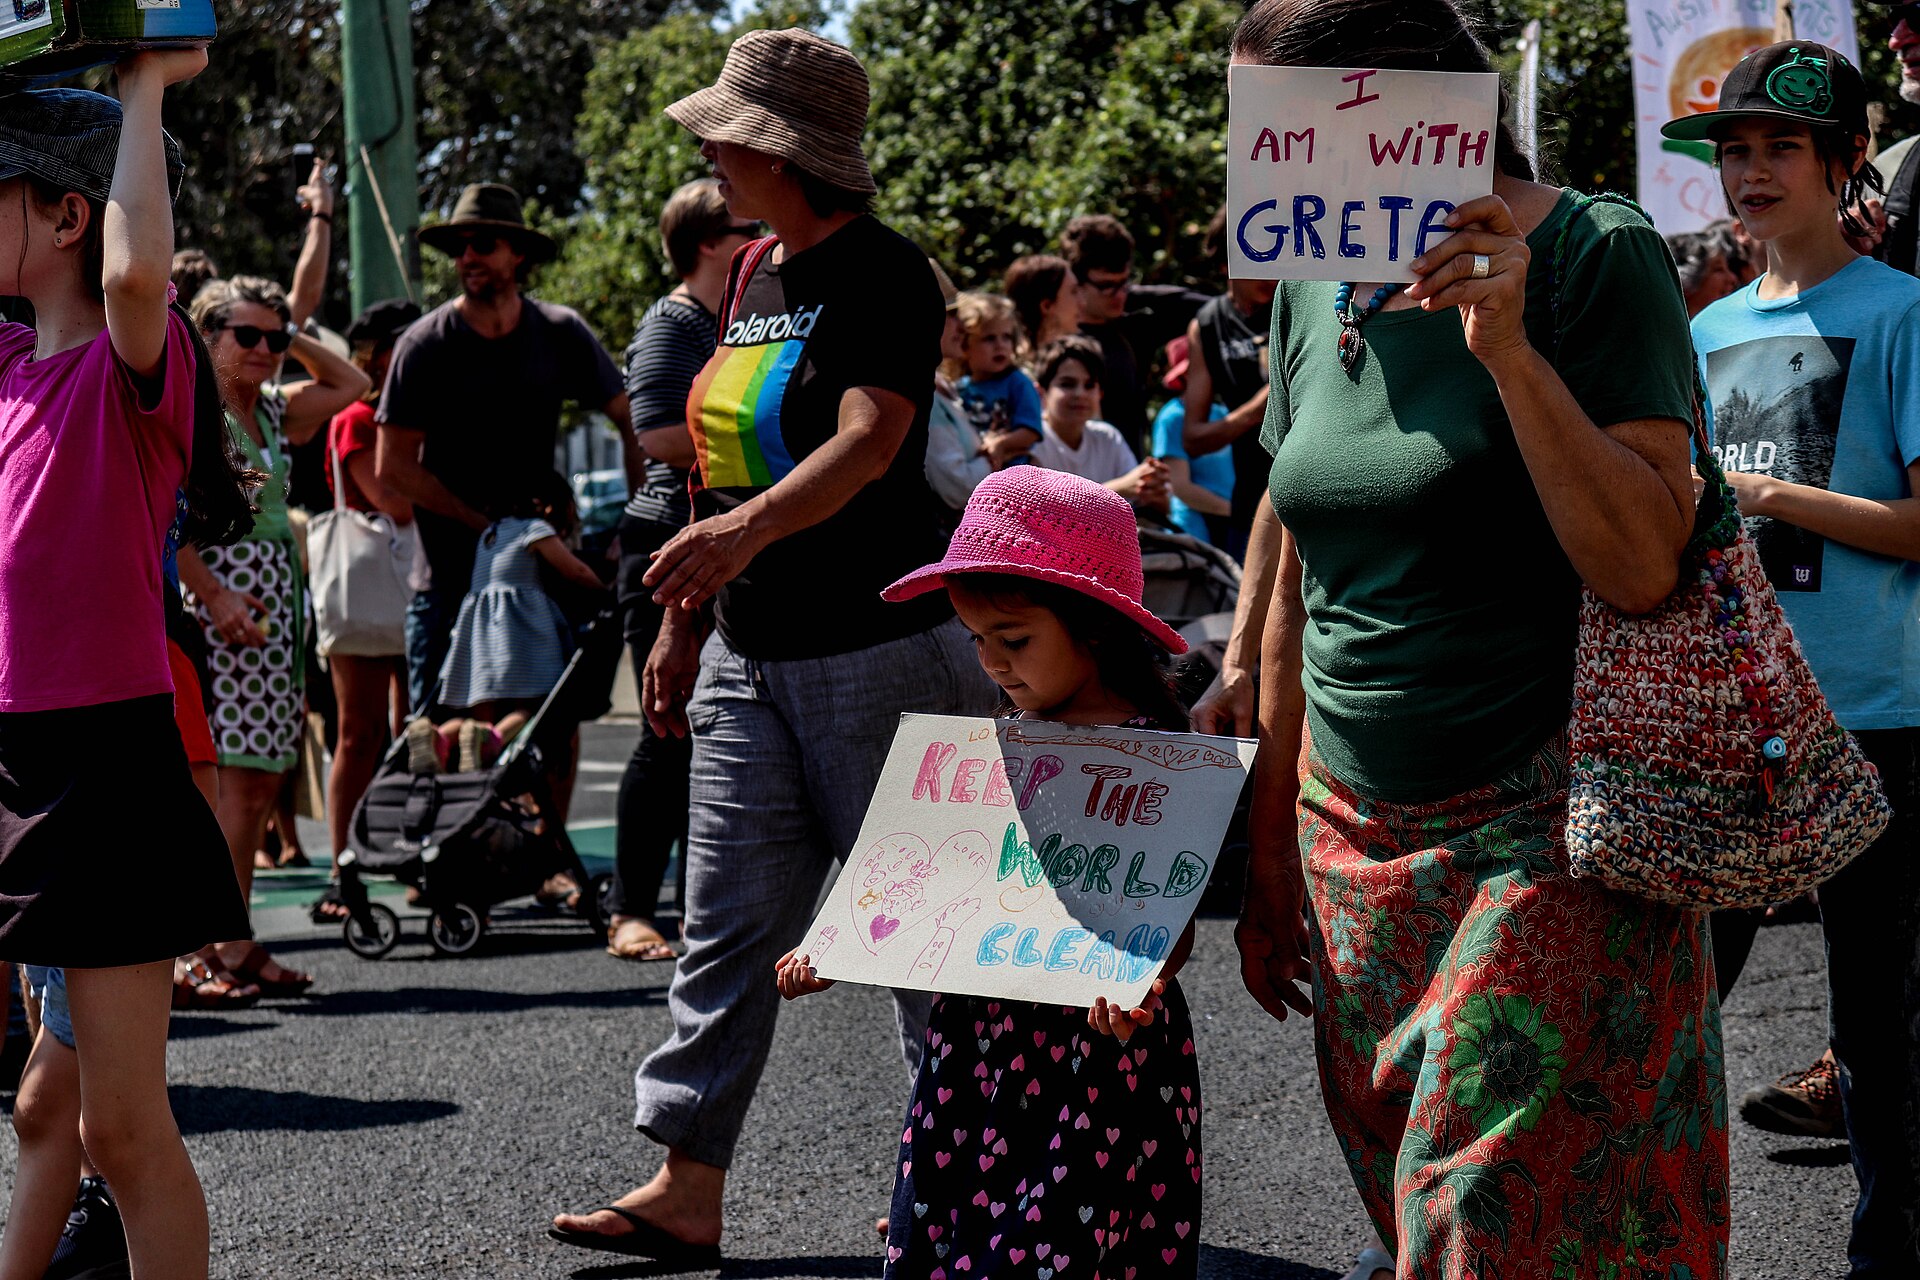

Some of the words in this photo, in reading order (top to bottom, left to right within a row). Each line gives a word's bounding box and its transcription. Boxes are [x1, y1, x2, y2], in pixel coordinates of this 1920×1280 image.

[1336, 70, 1379, 110] I
[1251, 127, 1314, 164] AM
[1236, 195, 1459, 262] GRETA
[723, 304, 824, 344] olaroid
[1712, 440, 1777, 472] ORLD
[969, 725, 1022, 742] LOVE
[912, 741, 1064, 811] KEEP
[1081, 764, 1169, 826] THE
[954, 843, 987, 868] LOVE
[997, 822, 1208, 898] WORLD
[976, 922, 1170, 983] CLEAN
